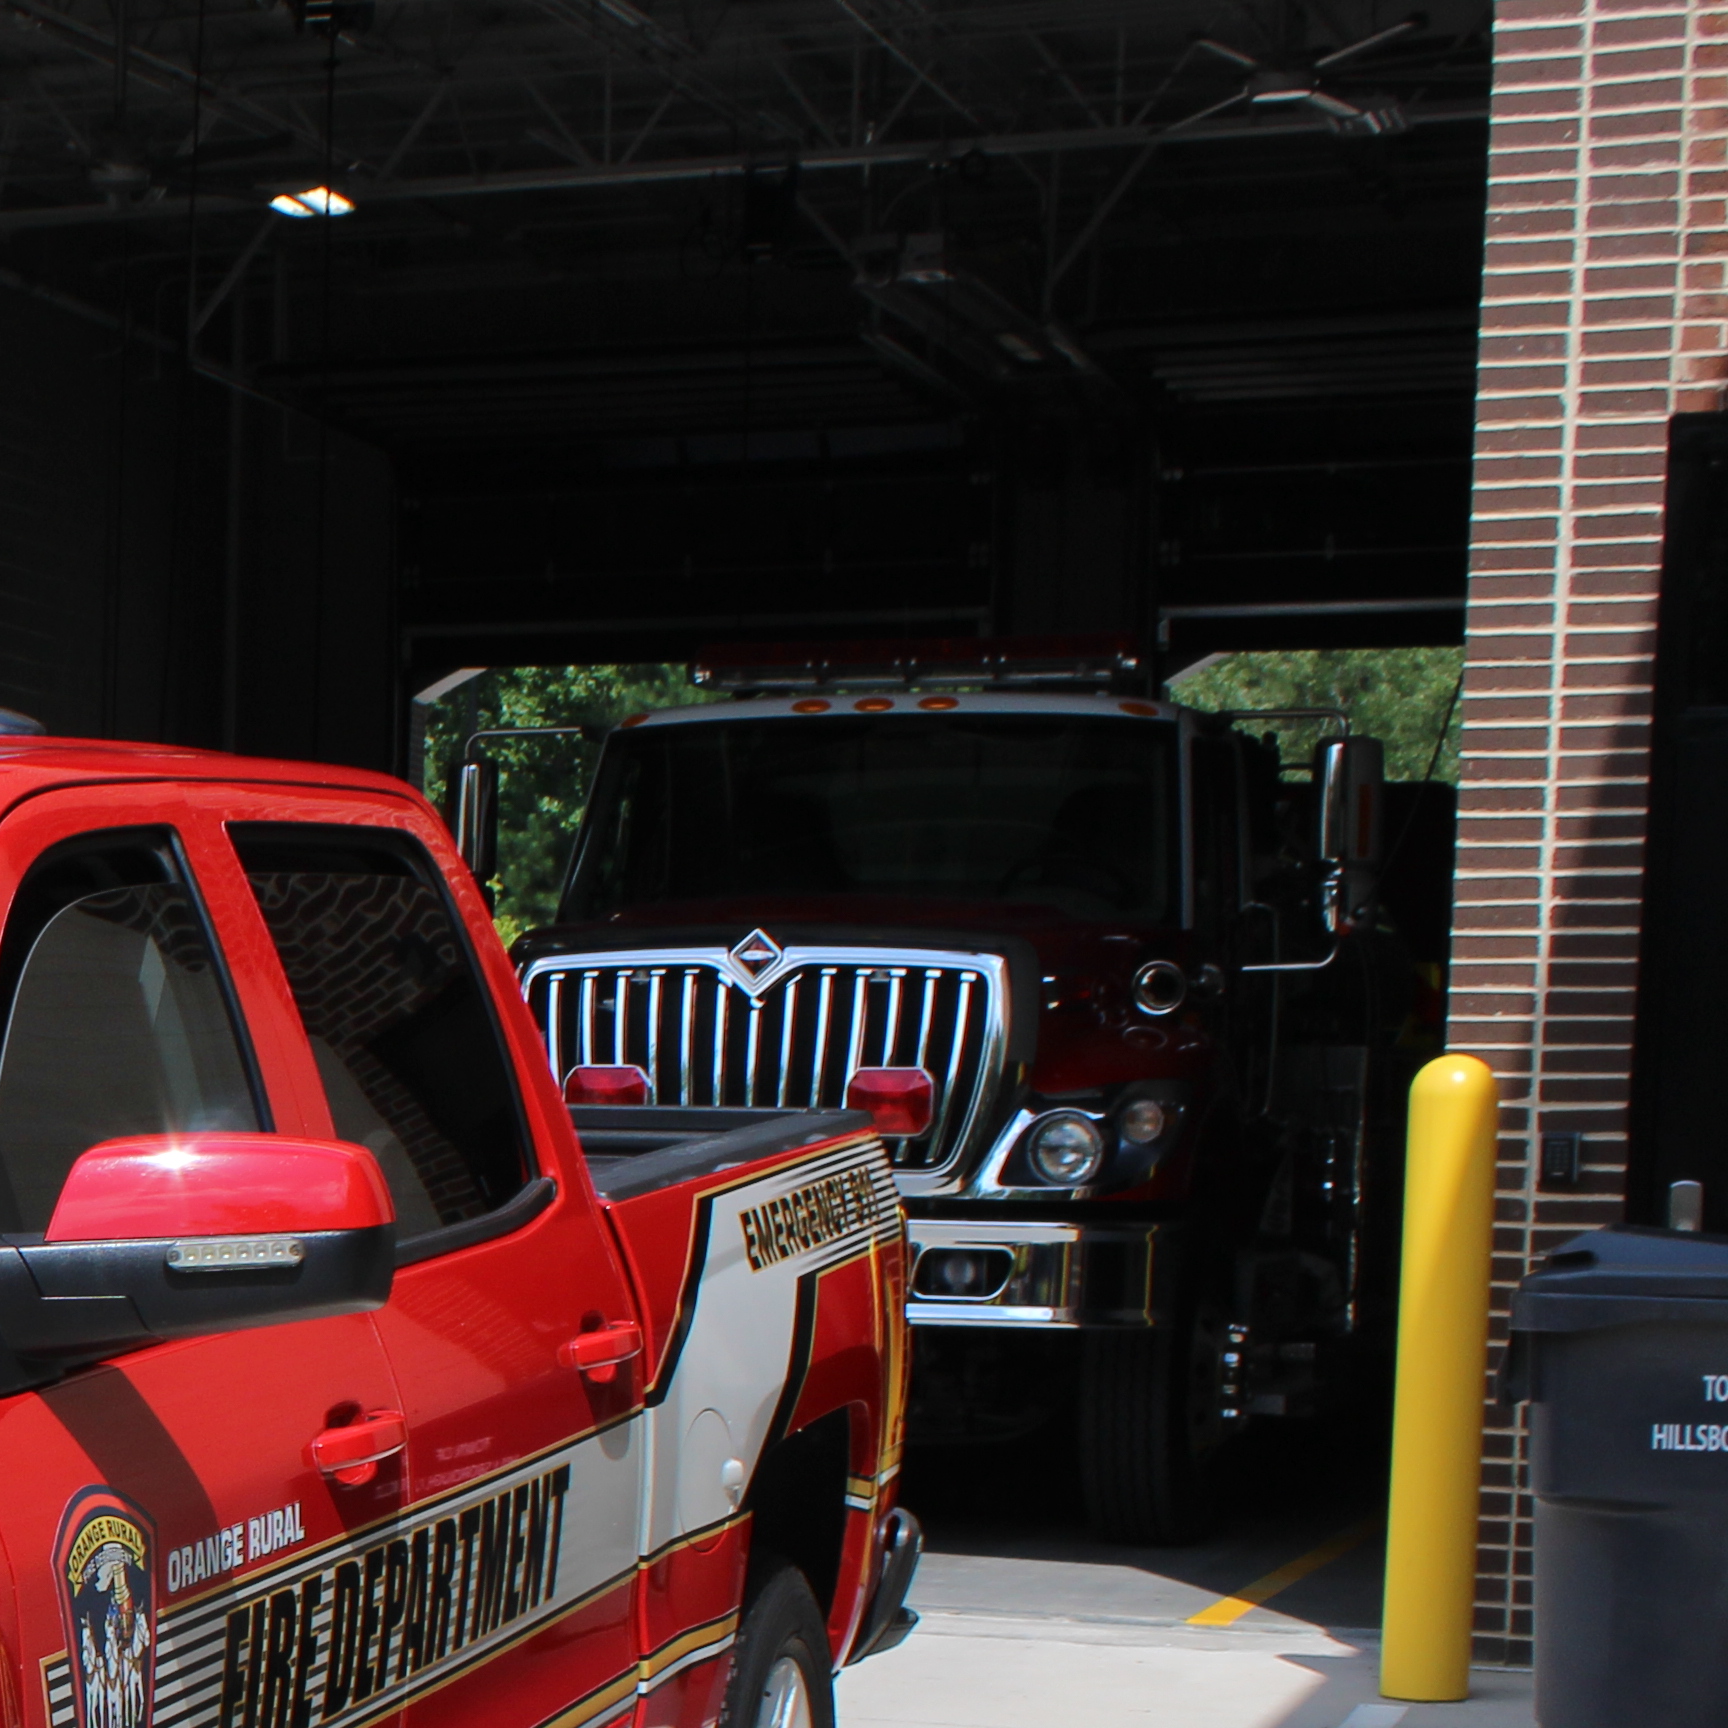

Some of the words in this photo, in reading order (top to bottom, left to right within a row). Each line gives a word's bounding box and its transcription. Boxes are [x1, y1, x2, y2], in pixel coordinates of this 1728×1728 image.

[738, 1175, 851, 1274] EMERGENCY
[71, 1520, 106, 1573] ORANGE
[106, 1520, 142, 1551] RURAL
[168, 1523, 244, 1592] ORANGE
[248, 1503, 306, 1561] RURAL
[322, 1463, 571, 1718] DEPARTMENT
